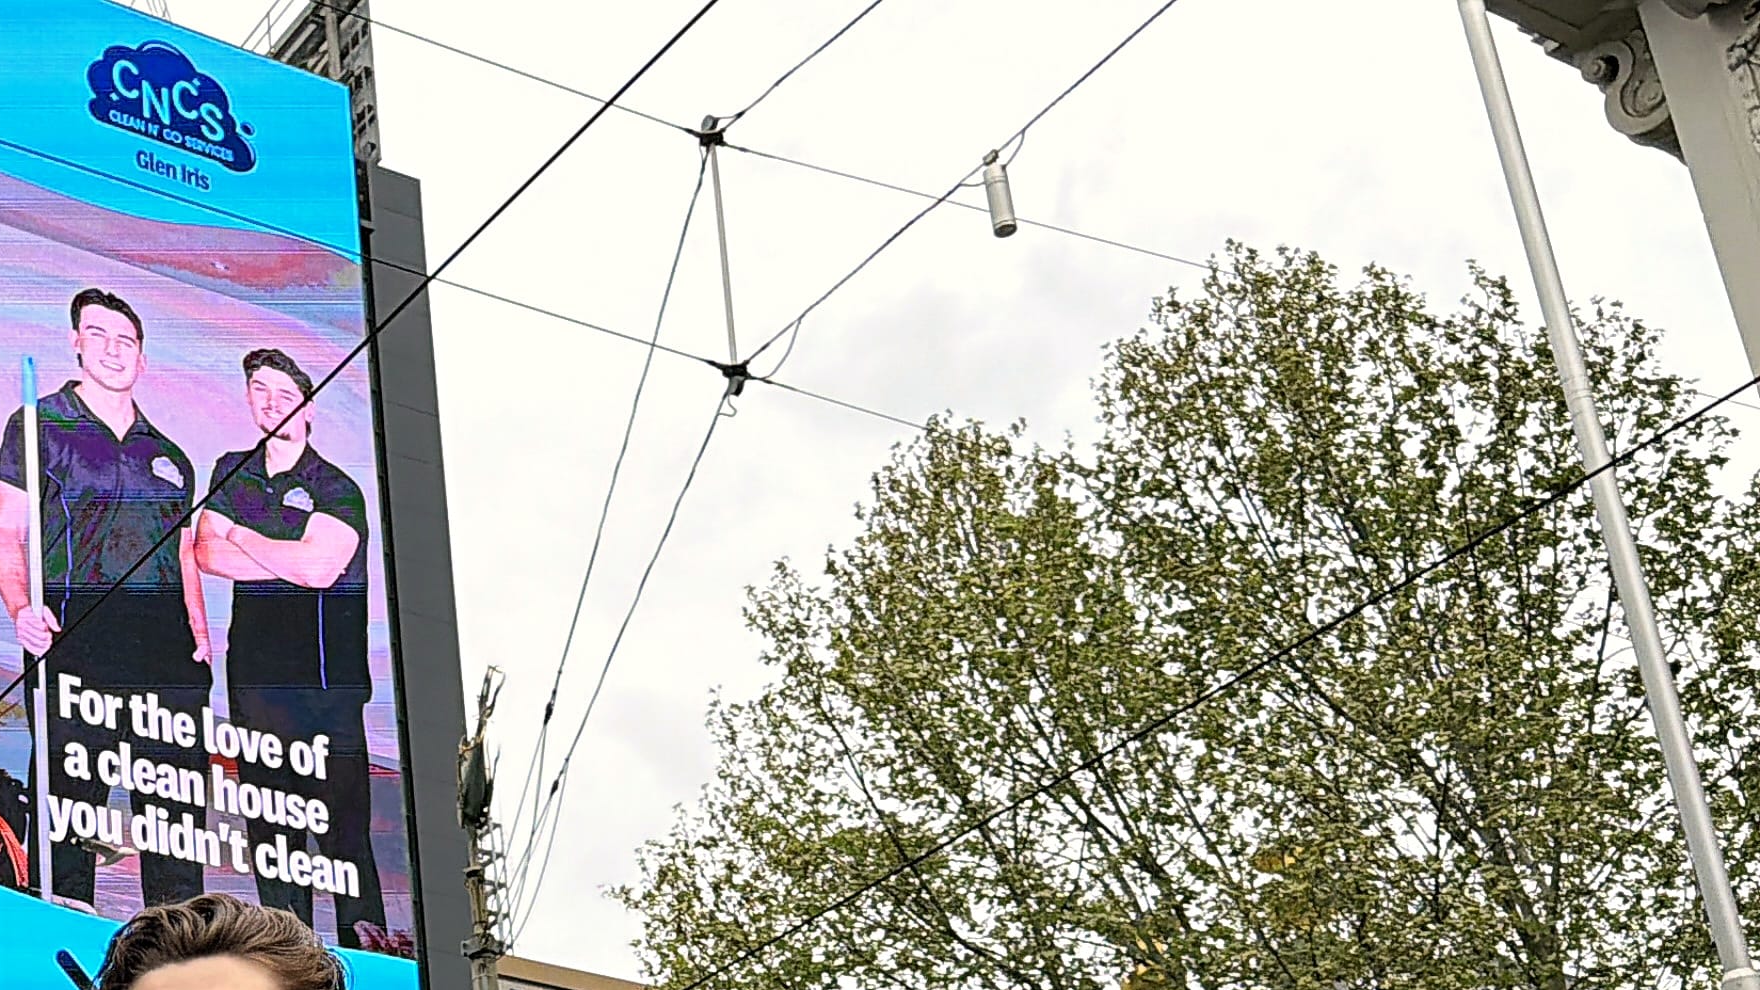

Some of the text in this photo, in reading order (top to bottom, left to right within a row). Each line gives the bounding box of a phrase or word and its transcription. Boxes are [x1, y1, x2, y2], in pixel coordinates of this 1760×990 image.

[112, 59, 225, 142] CNCS
[163, 128, 183, 143] CO
[135, 150, 211, 191] Glen Iris
[58, 673, 330, 781] For the love of
[63, 741, 330, 834] a clean house
[47, 795, 360, 899] you didn't clean
